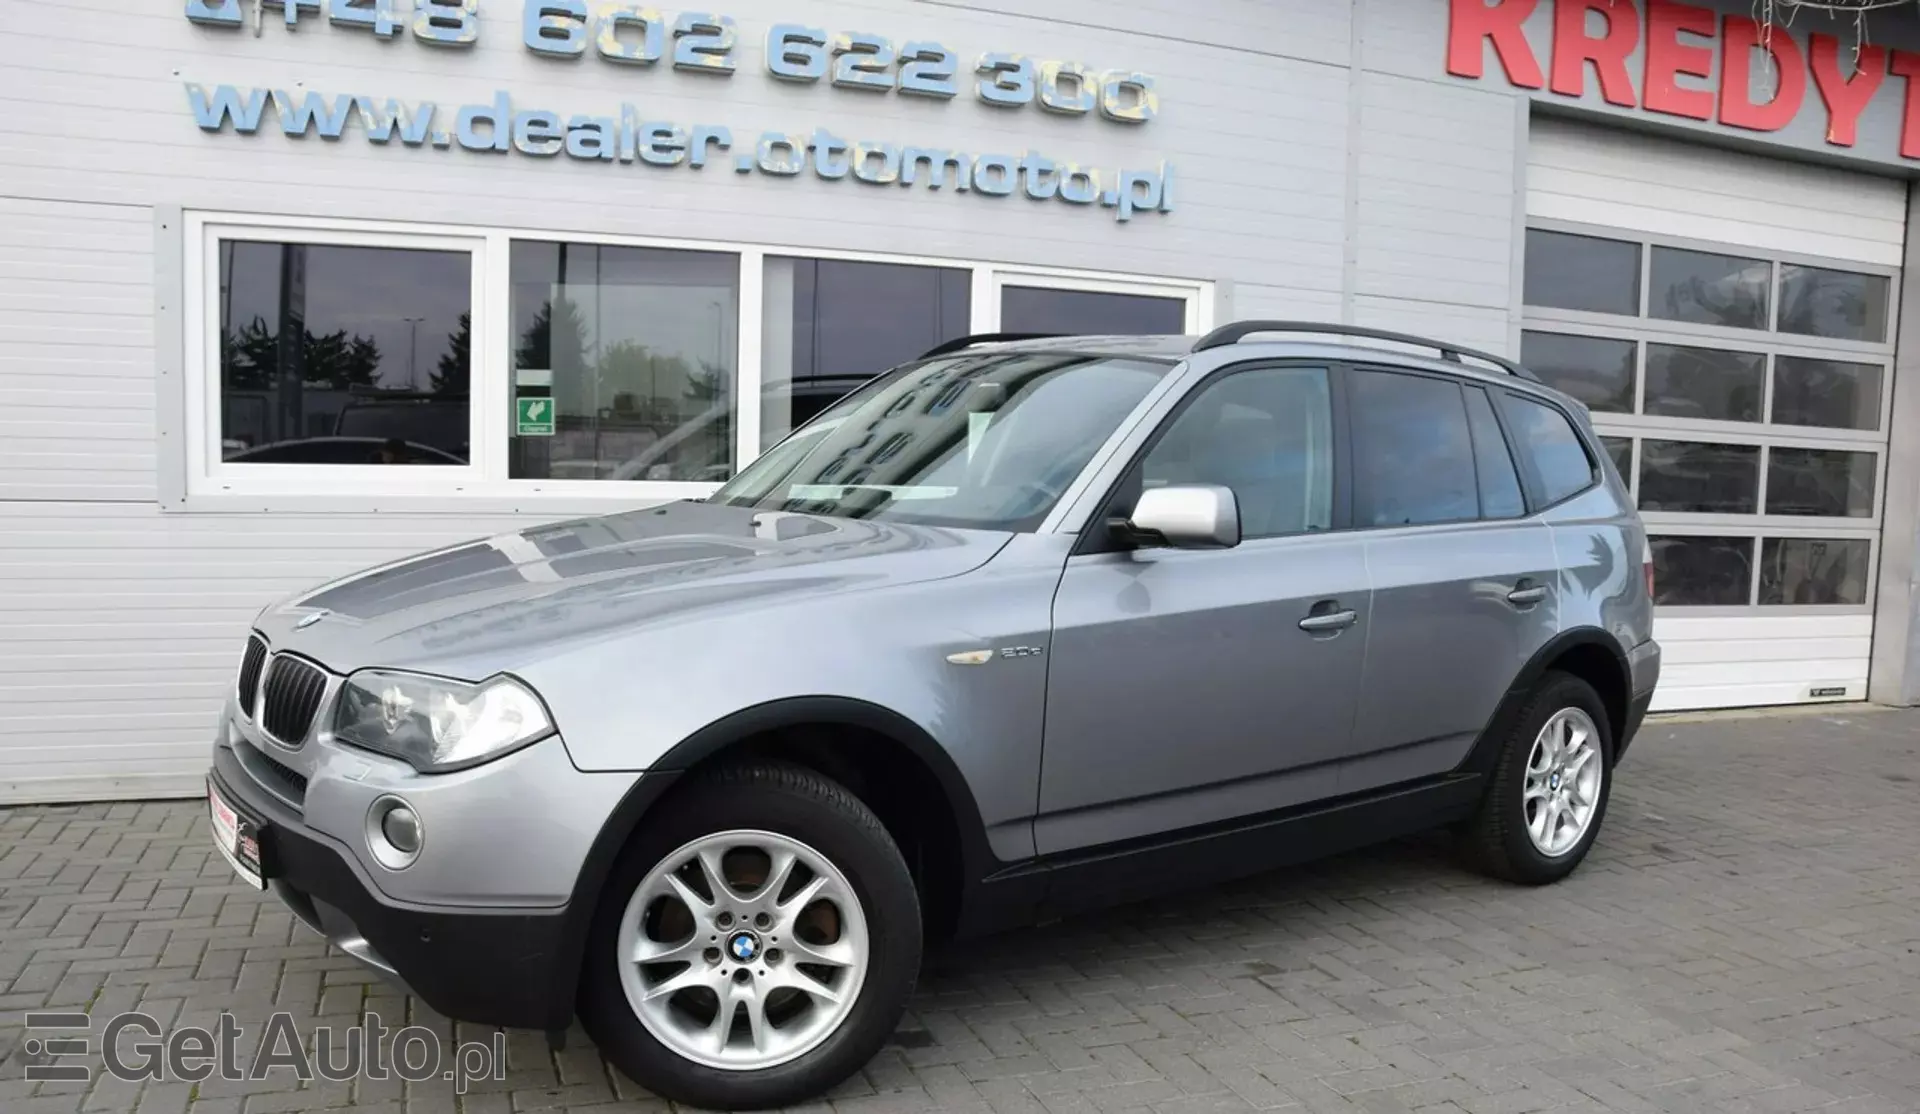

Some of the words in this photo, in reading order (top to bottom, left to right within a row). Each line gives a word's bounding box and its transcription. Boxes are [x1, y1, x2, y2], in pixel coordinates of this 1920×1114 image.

[523, 0, 738, 75] 602
[766, 23, 958, 101] 622
[975, 51, 1160, 124] 300
[183, 81, 1175, 223] www.dealer.otomoto.pl
